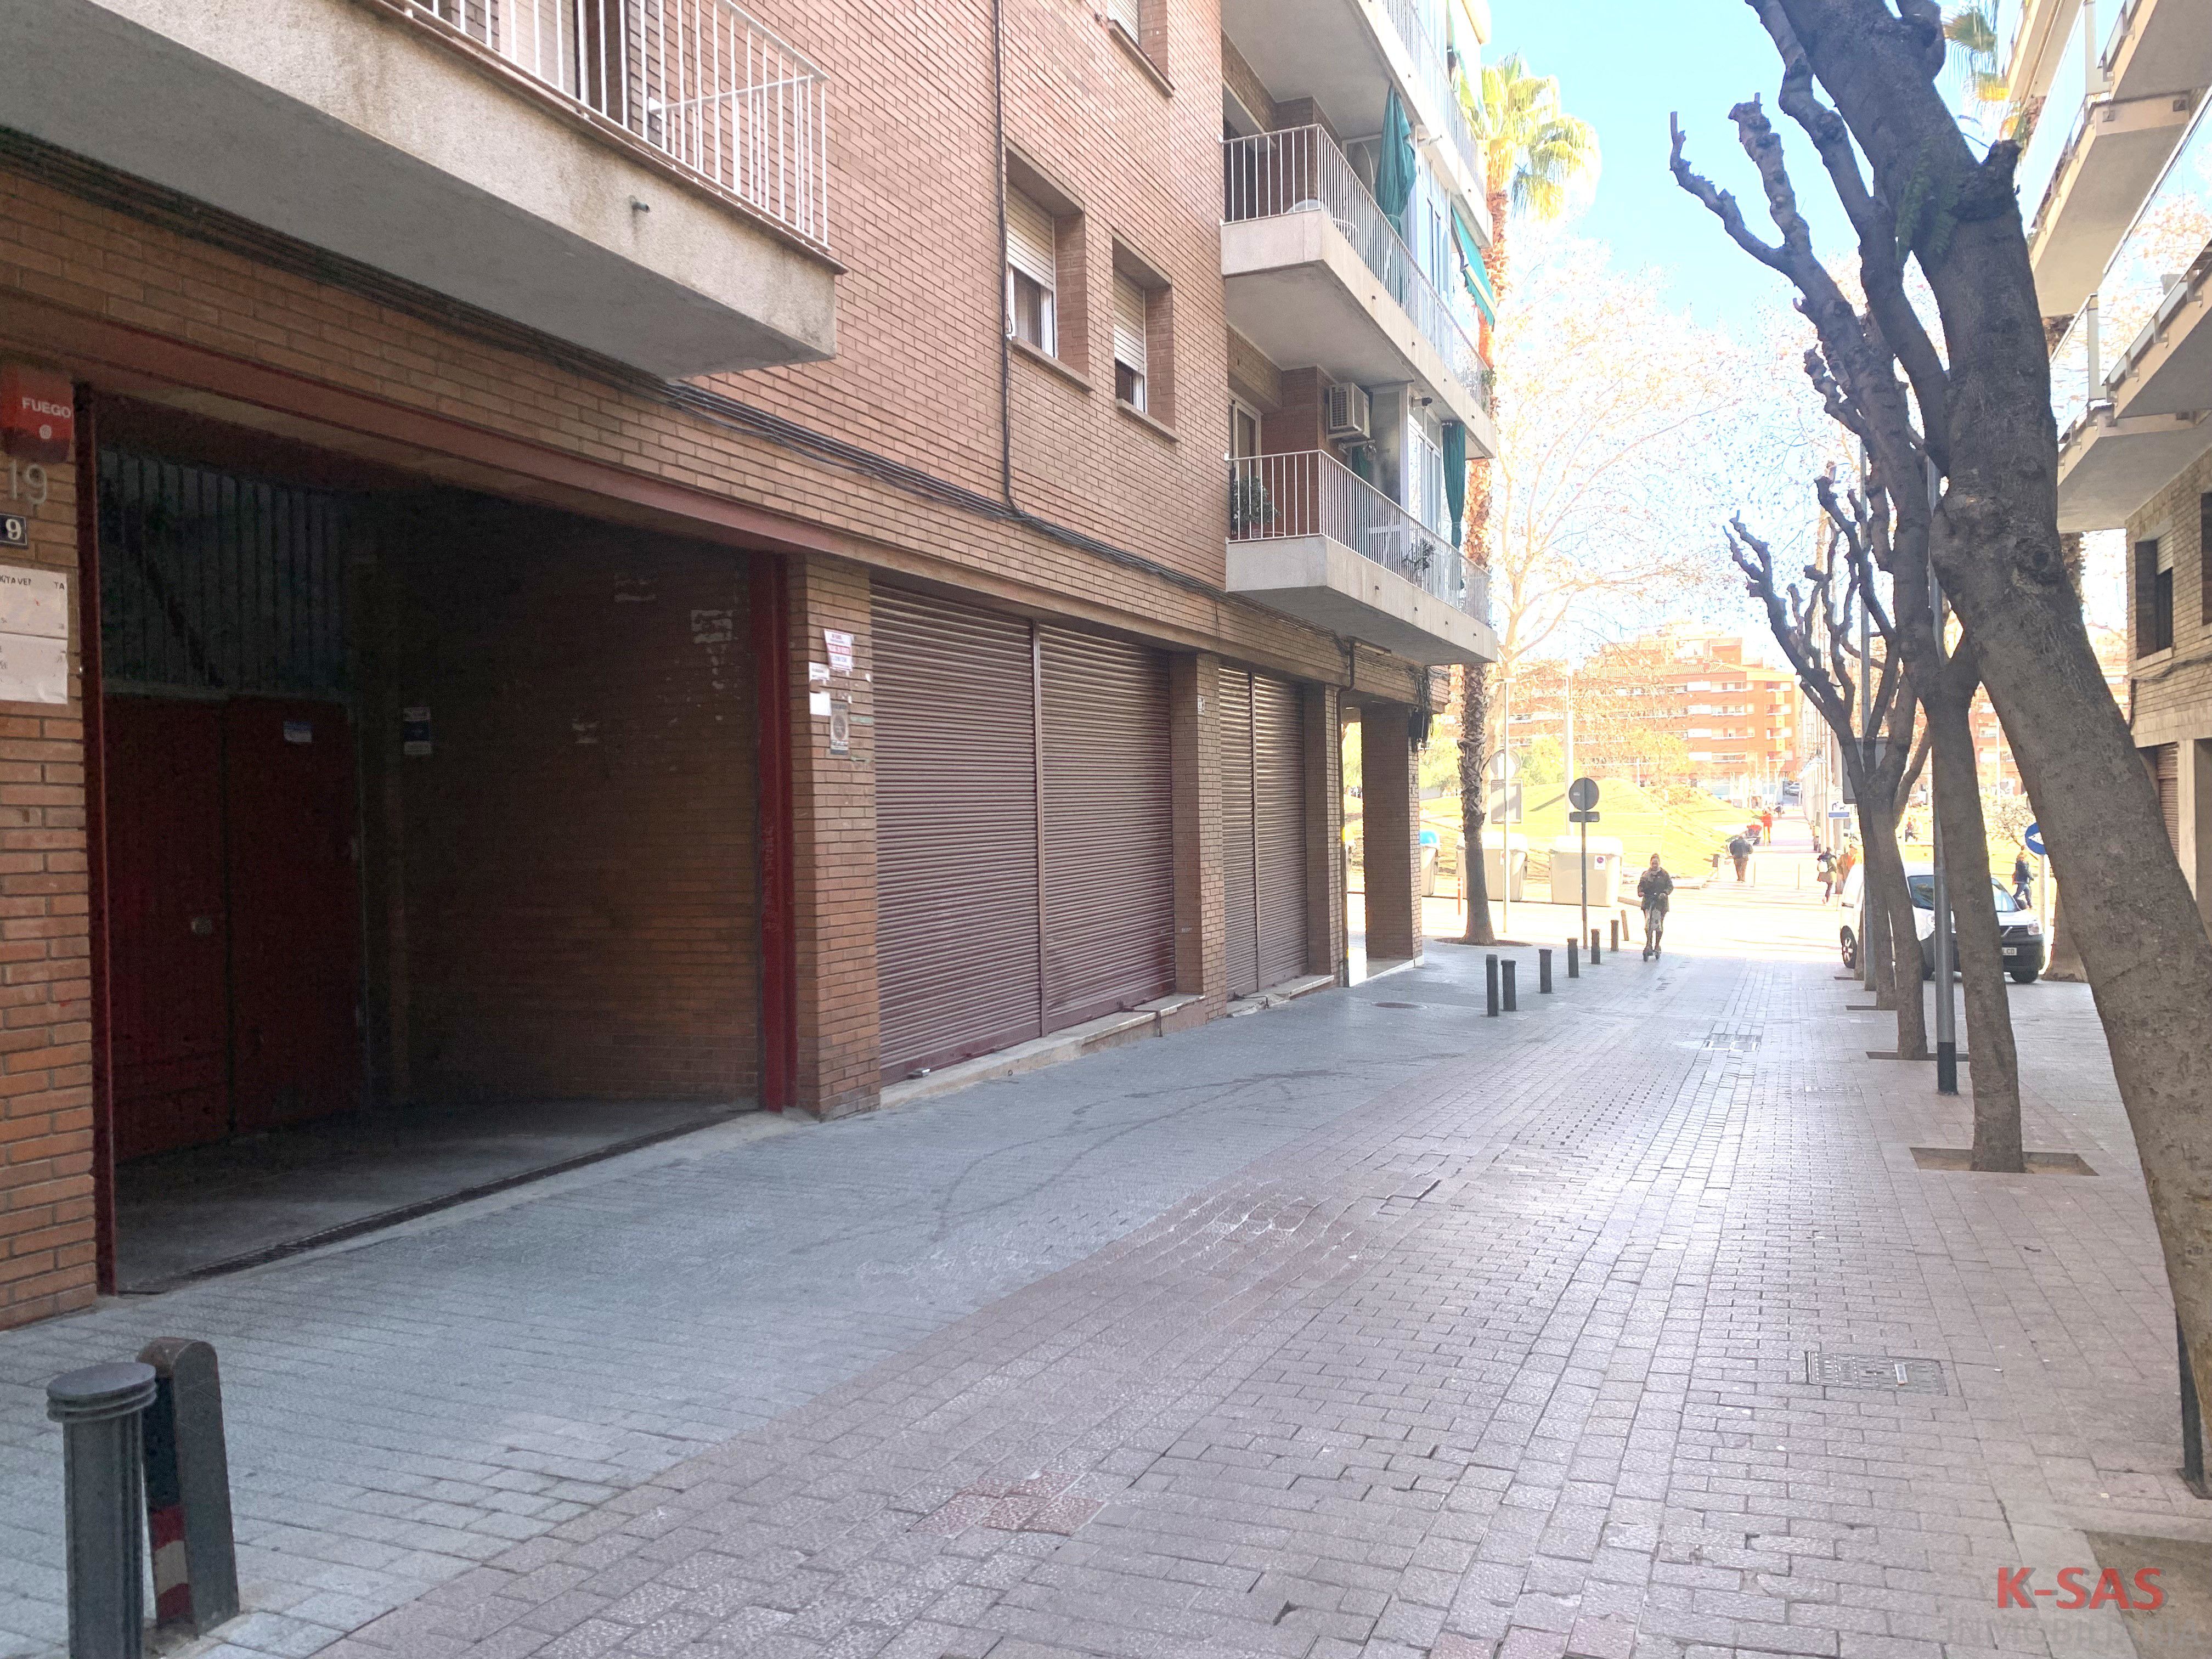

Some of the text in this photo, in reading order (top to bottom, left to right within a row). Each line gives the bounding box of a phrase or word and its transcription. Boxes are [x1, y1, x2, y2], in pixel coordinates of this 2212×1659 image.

[22, 397, 71, 419] FUEGO
[9, 460, 47, 504] 19
[5, 518, 21, 540] 9
